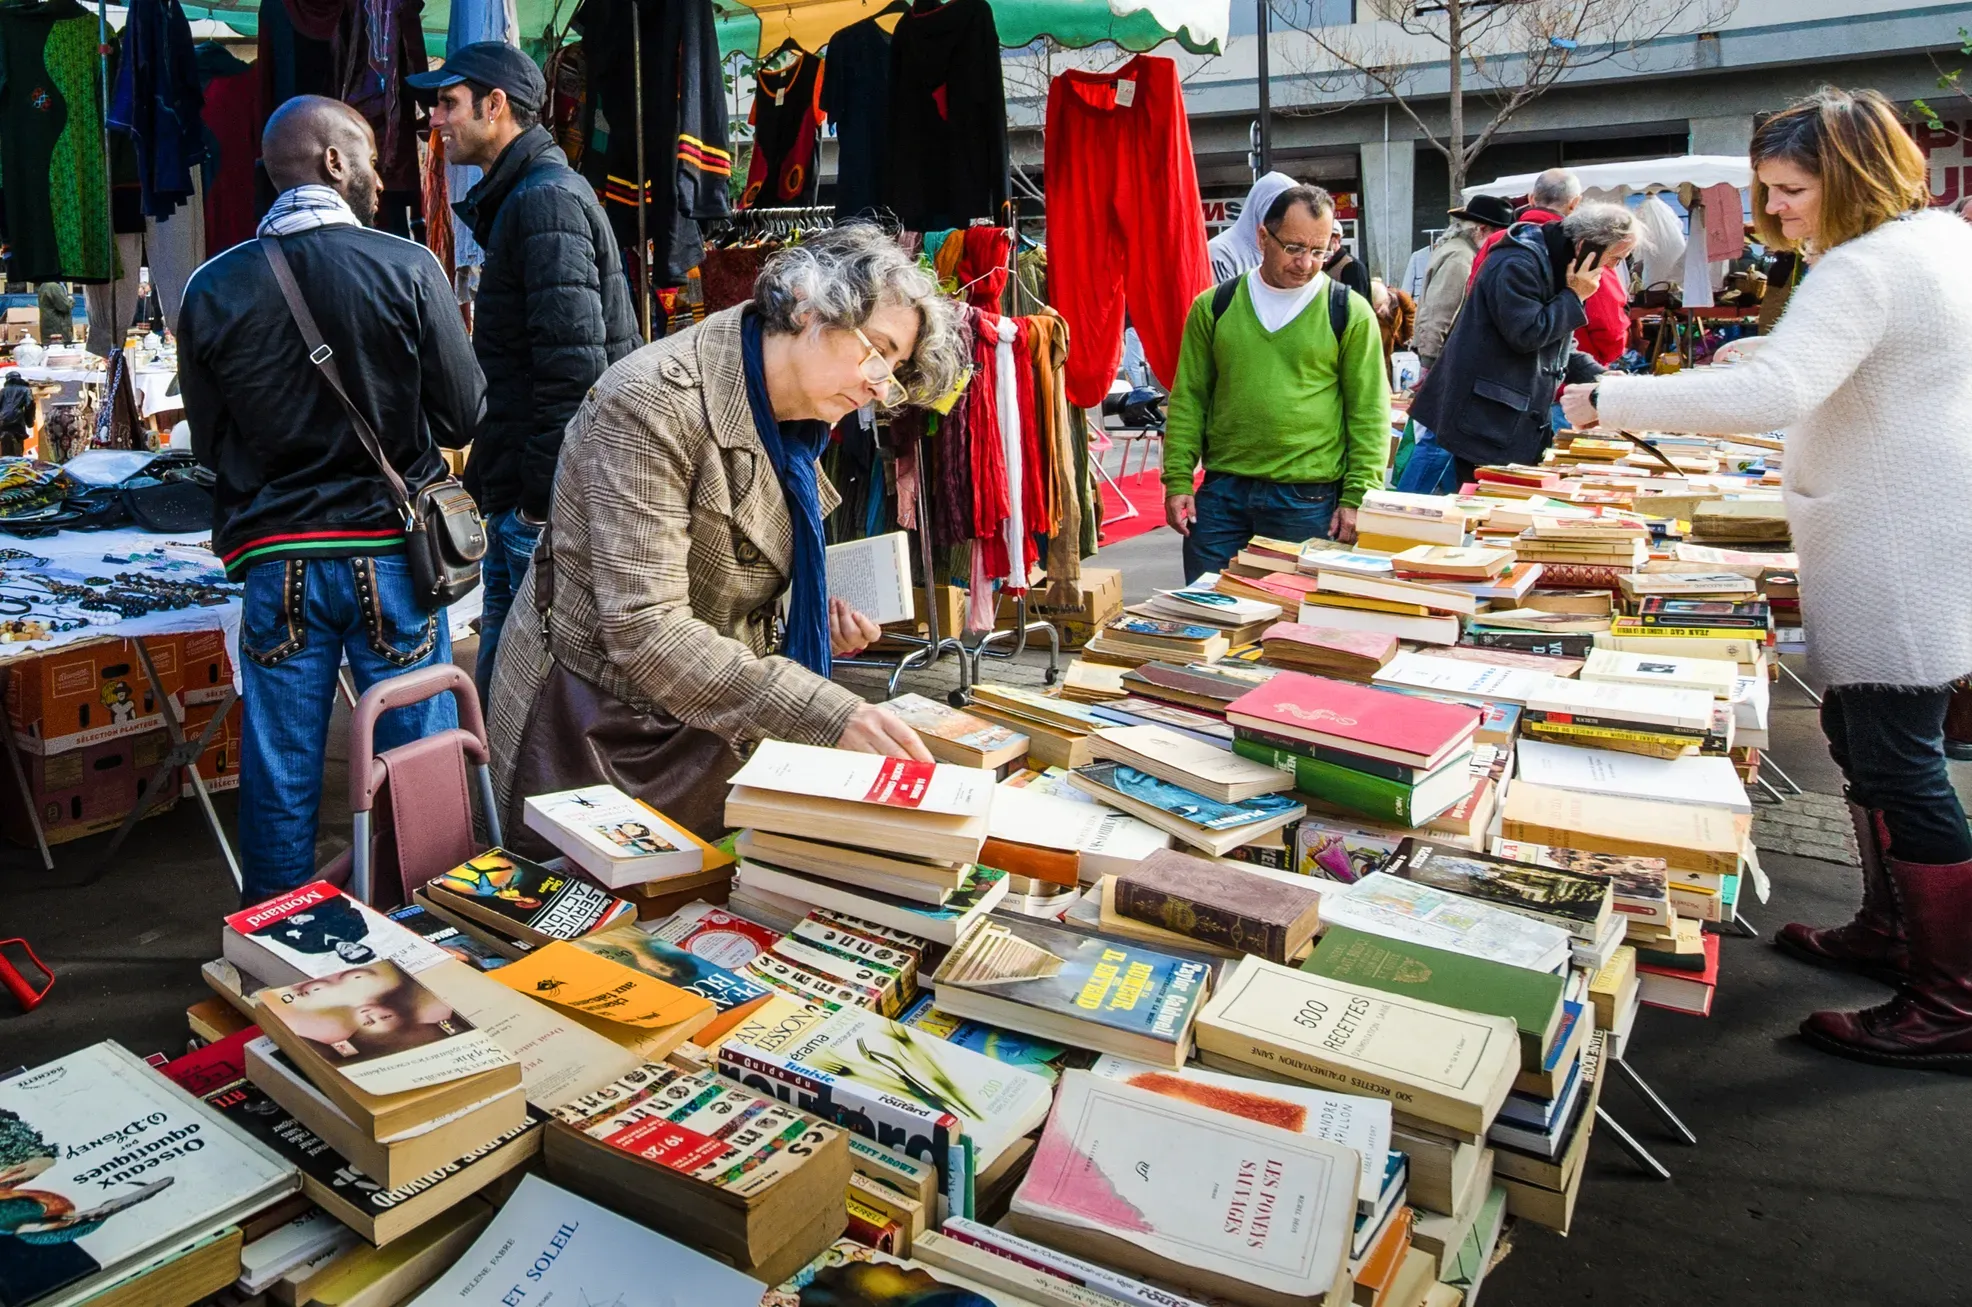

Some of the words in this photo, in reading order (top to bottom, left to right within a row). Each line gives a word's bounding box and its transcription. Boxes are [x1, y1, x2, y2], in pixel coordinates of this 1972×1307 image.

[1670, 628, 1685, 637] CAU
[1688, 628, 1710, 637] JEAN
[205, 688, 230, 699] SÉLEC
[76, 728, 118, 745] SÉLECTION
[119, 719, 158, 735] PLANTEUR
[209, 778, 239, 790] SÉLECT
[245, 889, 324, 927] Montand
[536, 886, 589, 939] ACTION
[555, 888, 605, 940] SERVICE
[1076, 962, 1120, 1010] ENTEND
[1172, 962, 1202, 992] Taylor
[1151, 994, 1188, 1036] Caldwell
[1293, 999, 1330, 1029] 500
[1322, 996, 1370, 1052] RECETTES
[534, 1026, 565, 1049] Droit
[829, 1020, 866, 1049] restaurants
[447, 1043, 501, 1068] Sophie
[721, 1049, 734, 1061] le
[743, 1056, 785, 1079] Guide
[795, 1073, 811, 1088] du
[1250, 1046, 1275, 1061] SAINE
[783, 1060, 836, 1085] Tunisie
[1278, 1055, 1347, 1084] D'ALIMENTATION
[212, 1089, 248, 1108] RTL
[1350, 1077, 1391, 1097] RECETTES
[1394, 1090, 1414, 1104] 500
[877, 1094, 931, 1117] routard
[1319, 1099, 1339, 1143] HANDRE
[1335, 1102, 1353, 1148] APILLON
[71, 1121, 200, 1186] aquatiques
[119, 1137, 140, 1153] par
[787, 1121, 838, 1157] Les
[101, 1137, 205, 1189] Oiseaux
[849, 1139, 879, 1158] RISTY
[877, 1154, 919, 1176] BROWN
[1084, 1138, 1098, 1173] GALLIMARD
[1265, 1158, 1283, 1187] LES
[1224, 1158, 1258, 1236] SAUVAGES
[1246, 1187, 1276, 1250] PONEYS
[490, 1237, 516, 1266] FABRE
[526, 1219, 580, 1284] SOLEIL
